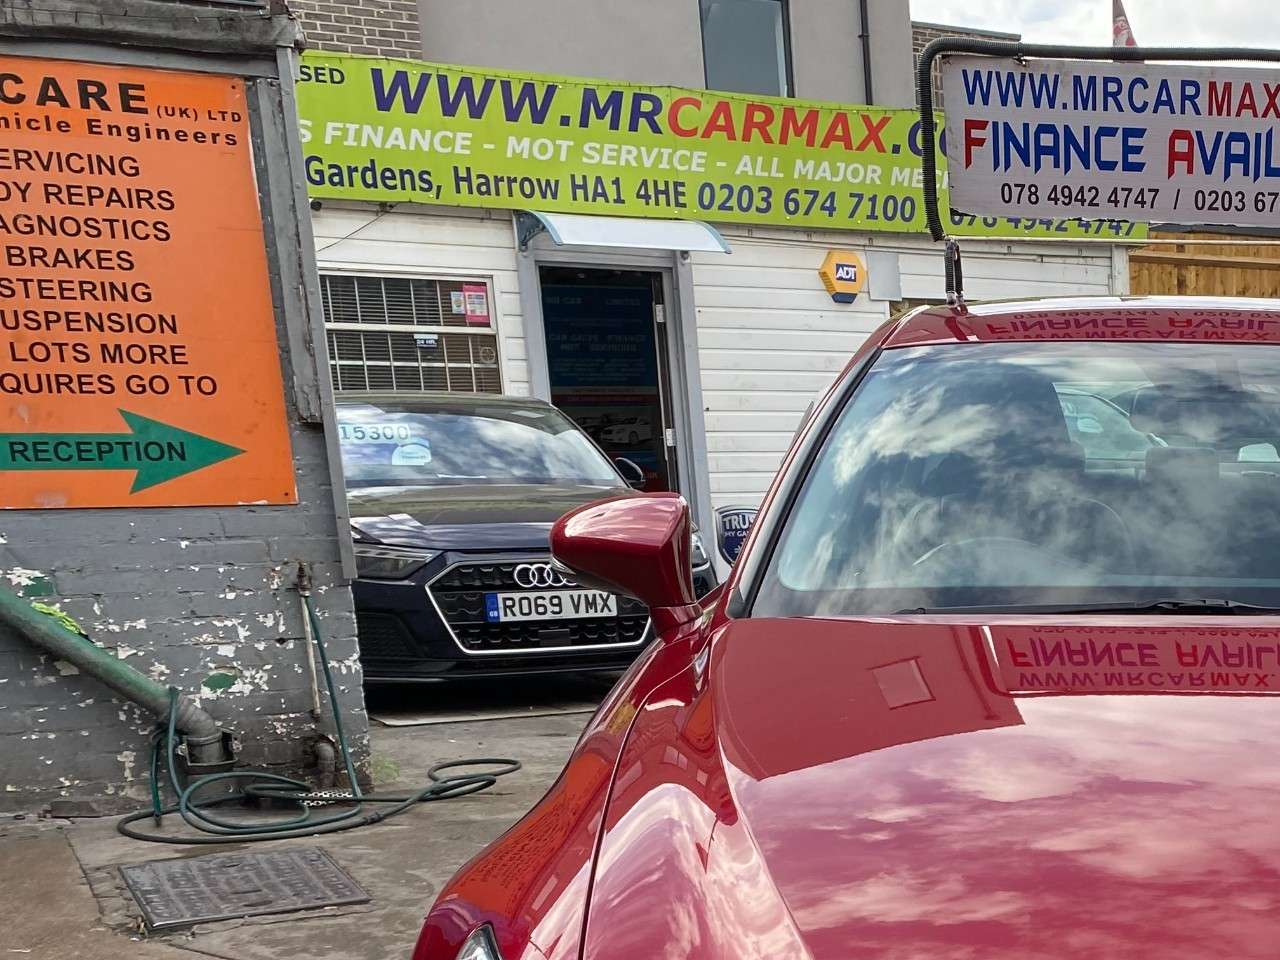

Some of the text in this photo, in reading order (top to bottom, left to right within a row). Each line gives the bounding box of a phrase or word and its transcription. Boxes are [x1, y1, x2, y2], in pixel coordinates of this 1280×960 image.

[300, 65, 345, 85] SED
[0, 72, 242, 123] CARE (UK) LTD
[87, 118, 238, 146] Engineers
[324, 121, 473, 155] FINANCE
[506, 135, 574, 162] MOT
[582, 142, 708, 172] SERVICE
[735, 154, 784, 178] ALL
[794, 159, 882, 185] MAJOR
[964, 118, 1148, 176] FINANCE
[43, 183, 176, 211] REPAIRS
[305, 155, 442, 200] Gardens,
[452, 165, 560, 200] Harrow
[570, 173, 626, 204] HA1
[636, 178, 687, 208] 4HE
[698, 182, 773, 214] 0203
[783, 187, 837, 218] 674
[848, 192, 916, 223] 7100
[1001, 182, 1040, 205] 078
[1047, 184, 1100, 207] 4942
[1107, 187, 1160, 209] 4747
[1173, 189, 1181, 210] /
[1194, 189, 1246, 212] 0203
[5, 245, 135, 271] BRAKES
[836, 266, 857, 280] ADT
[0, 277, 152, 303] STEERING
[0, 309, 178, 335] USPENSION
[9, 341, 189, 365] LOTS MORE
[0, 372, 218, 396] QUIRES GO TO
[340, 425, 410, 441] 15300
[8, 441, 187, 462] RECEPTION
[502, 593, 612, 617] RO69 VMX
